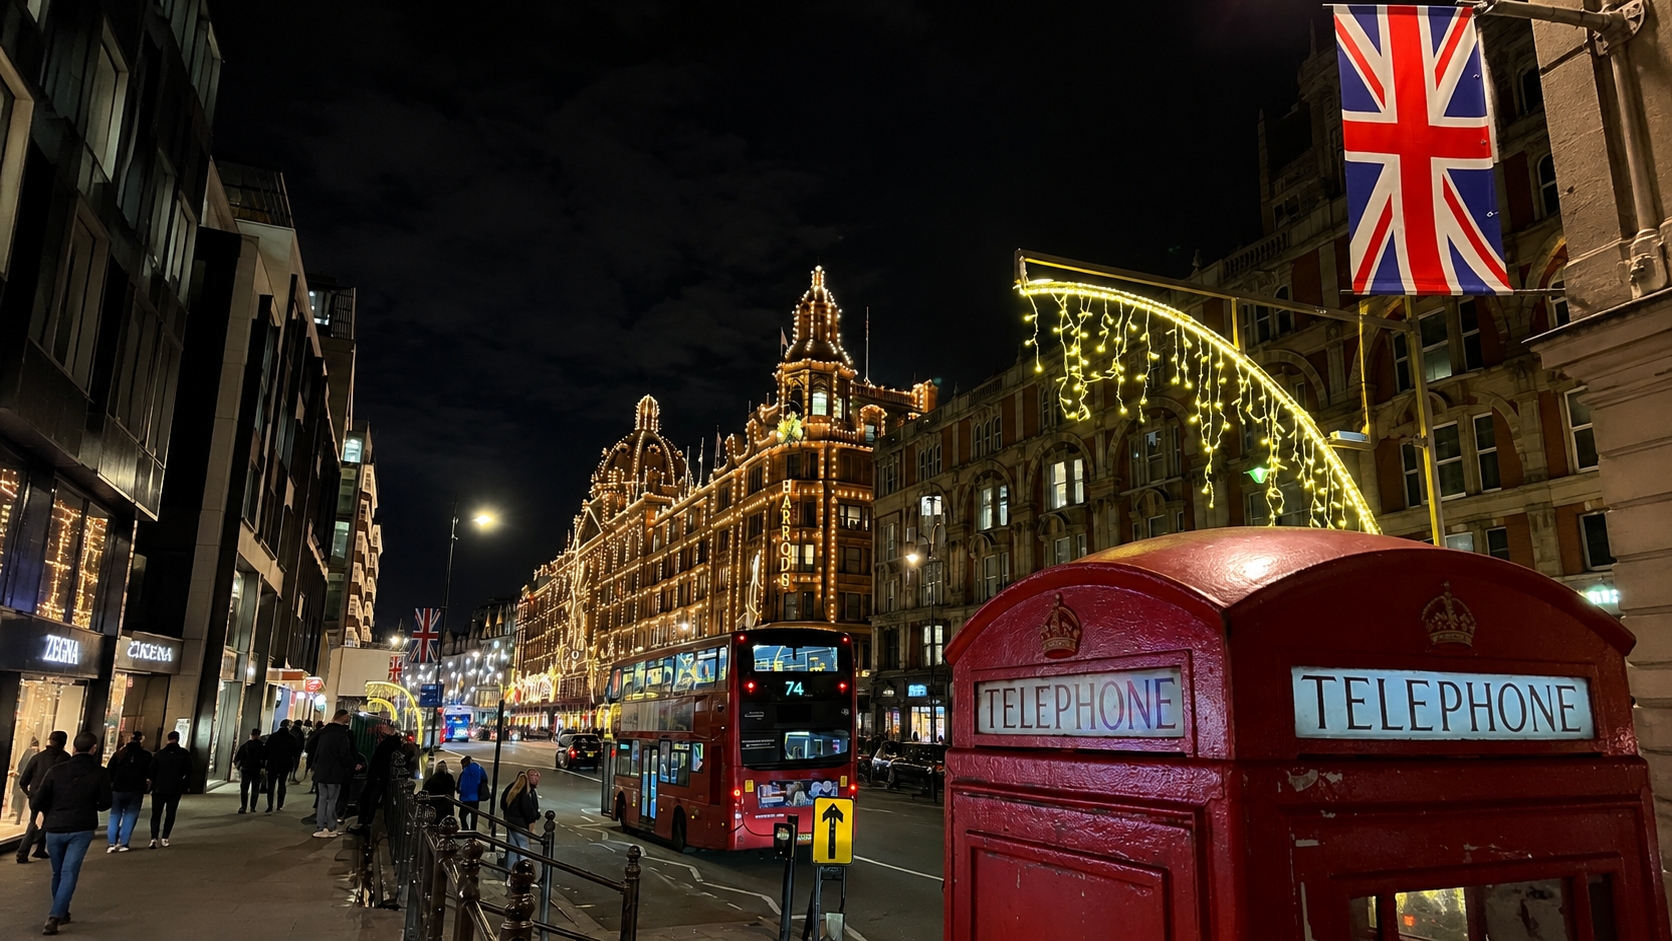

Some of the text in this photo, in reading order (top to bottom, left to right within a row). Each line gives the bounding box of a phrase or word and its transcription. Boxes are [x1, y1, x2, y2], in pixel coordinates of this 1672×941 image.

[780, 479, 792, 587] HARRODS
[44, 634, 79, 665] ZEGNA
[785, 681, 804, 696] 74
[984, 677, 1176, 730] TELEPHONE
[1301, 675, 1581, 733] TELEPHONE
